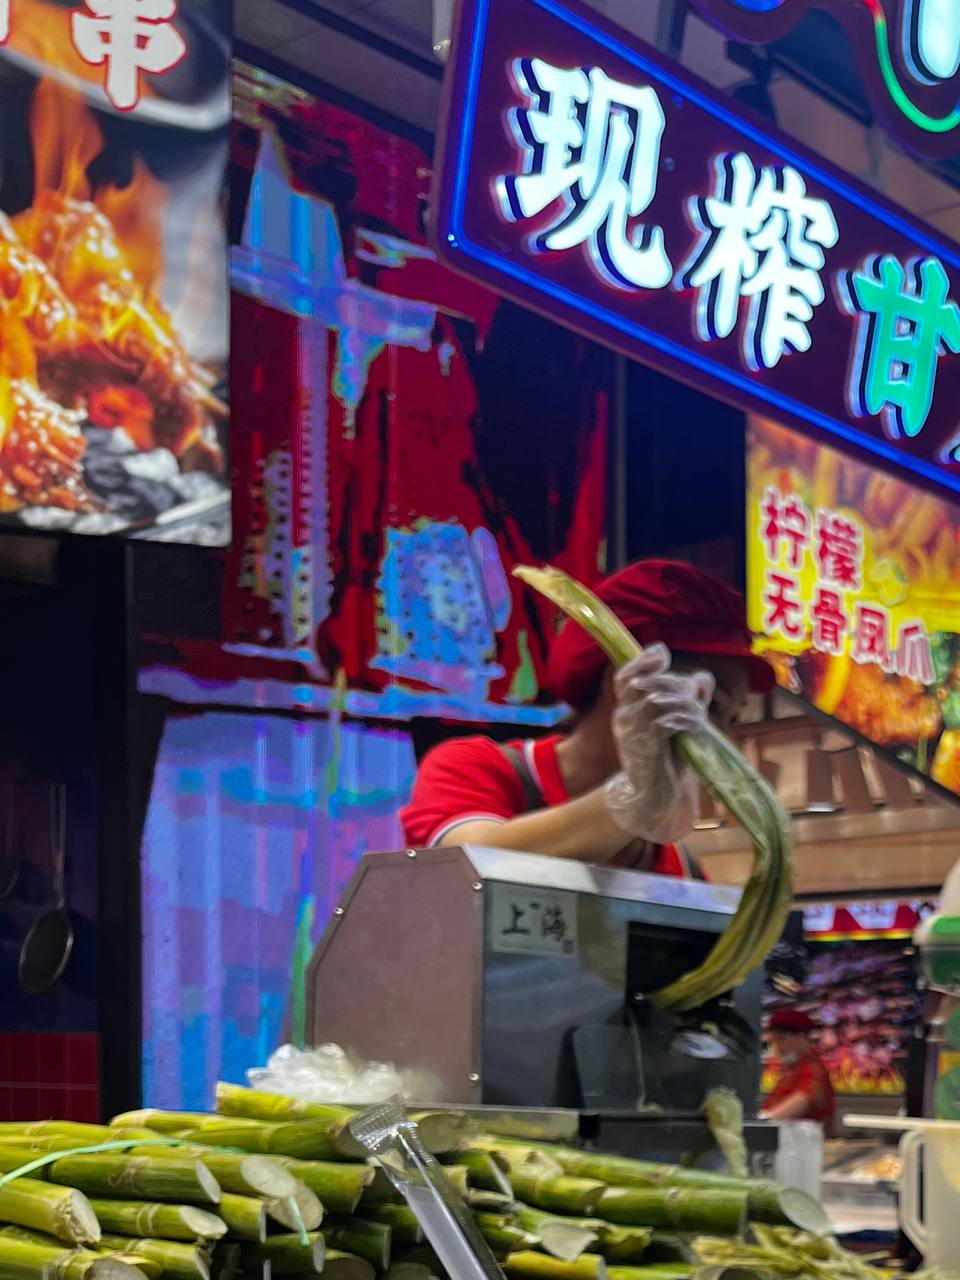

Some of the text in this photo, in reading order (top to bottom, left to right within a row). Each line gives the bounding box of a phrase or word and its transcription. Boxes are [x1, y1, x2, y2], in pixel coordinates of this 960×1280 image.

[760, 486, 866, 594] 柠檬
[763, 570, 938, 686] 无骨凤爪
